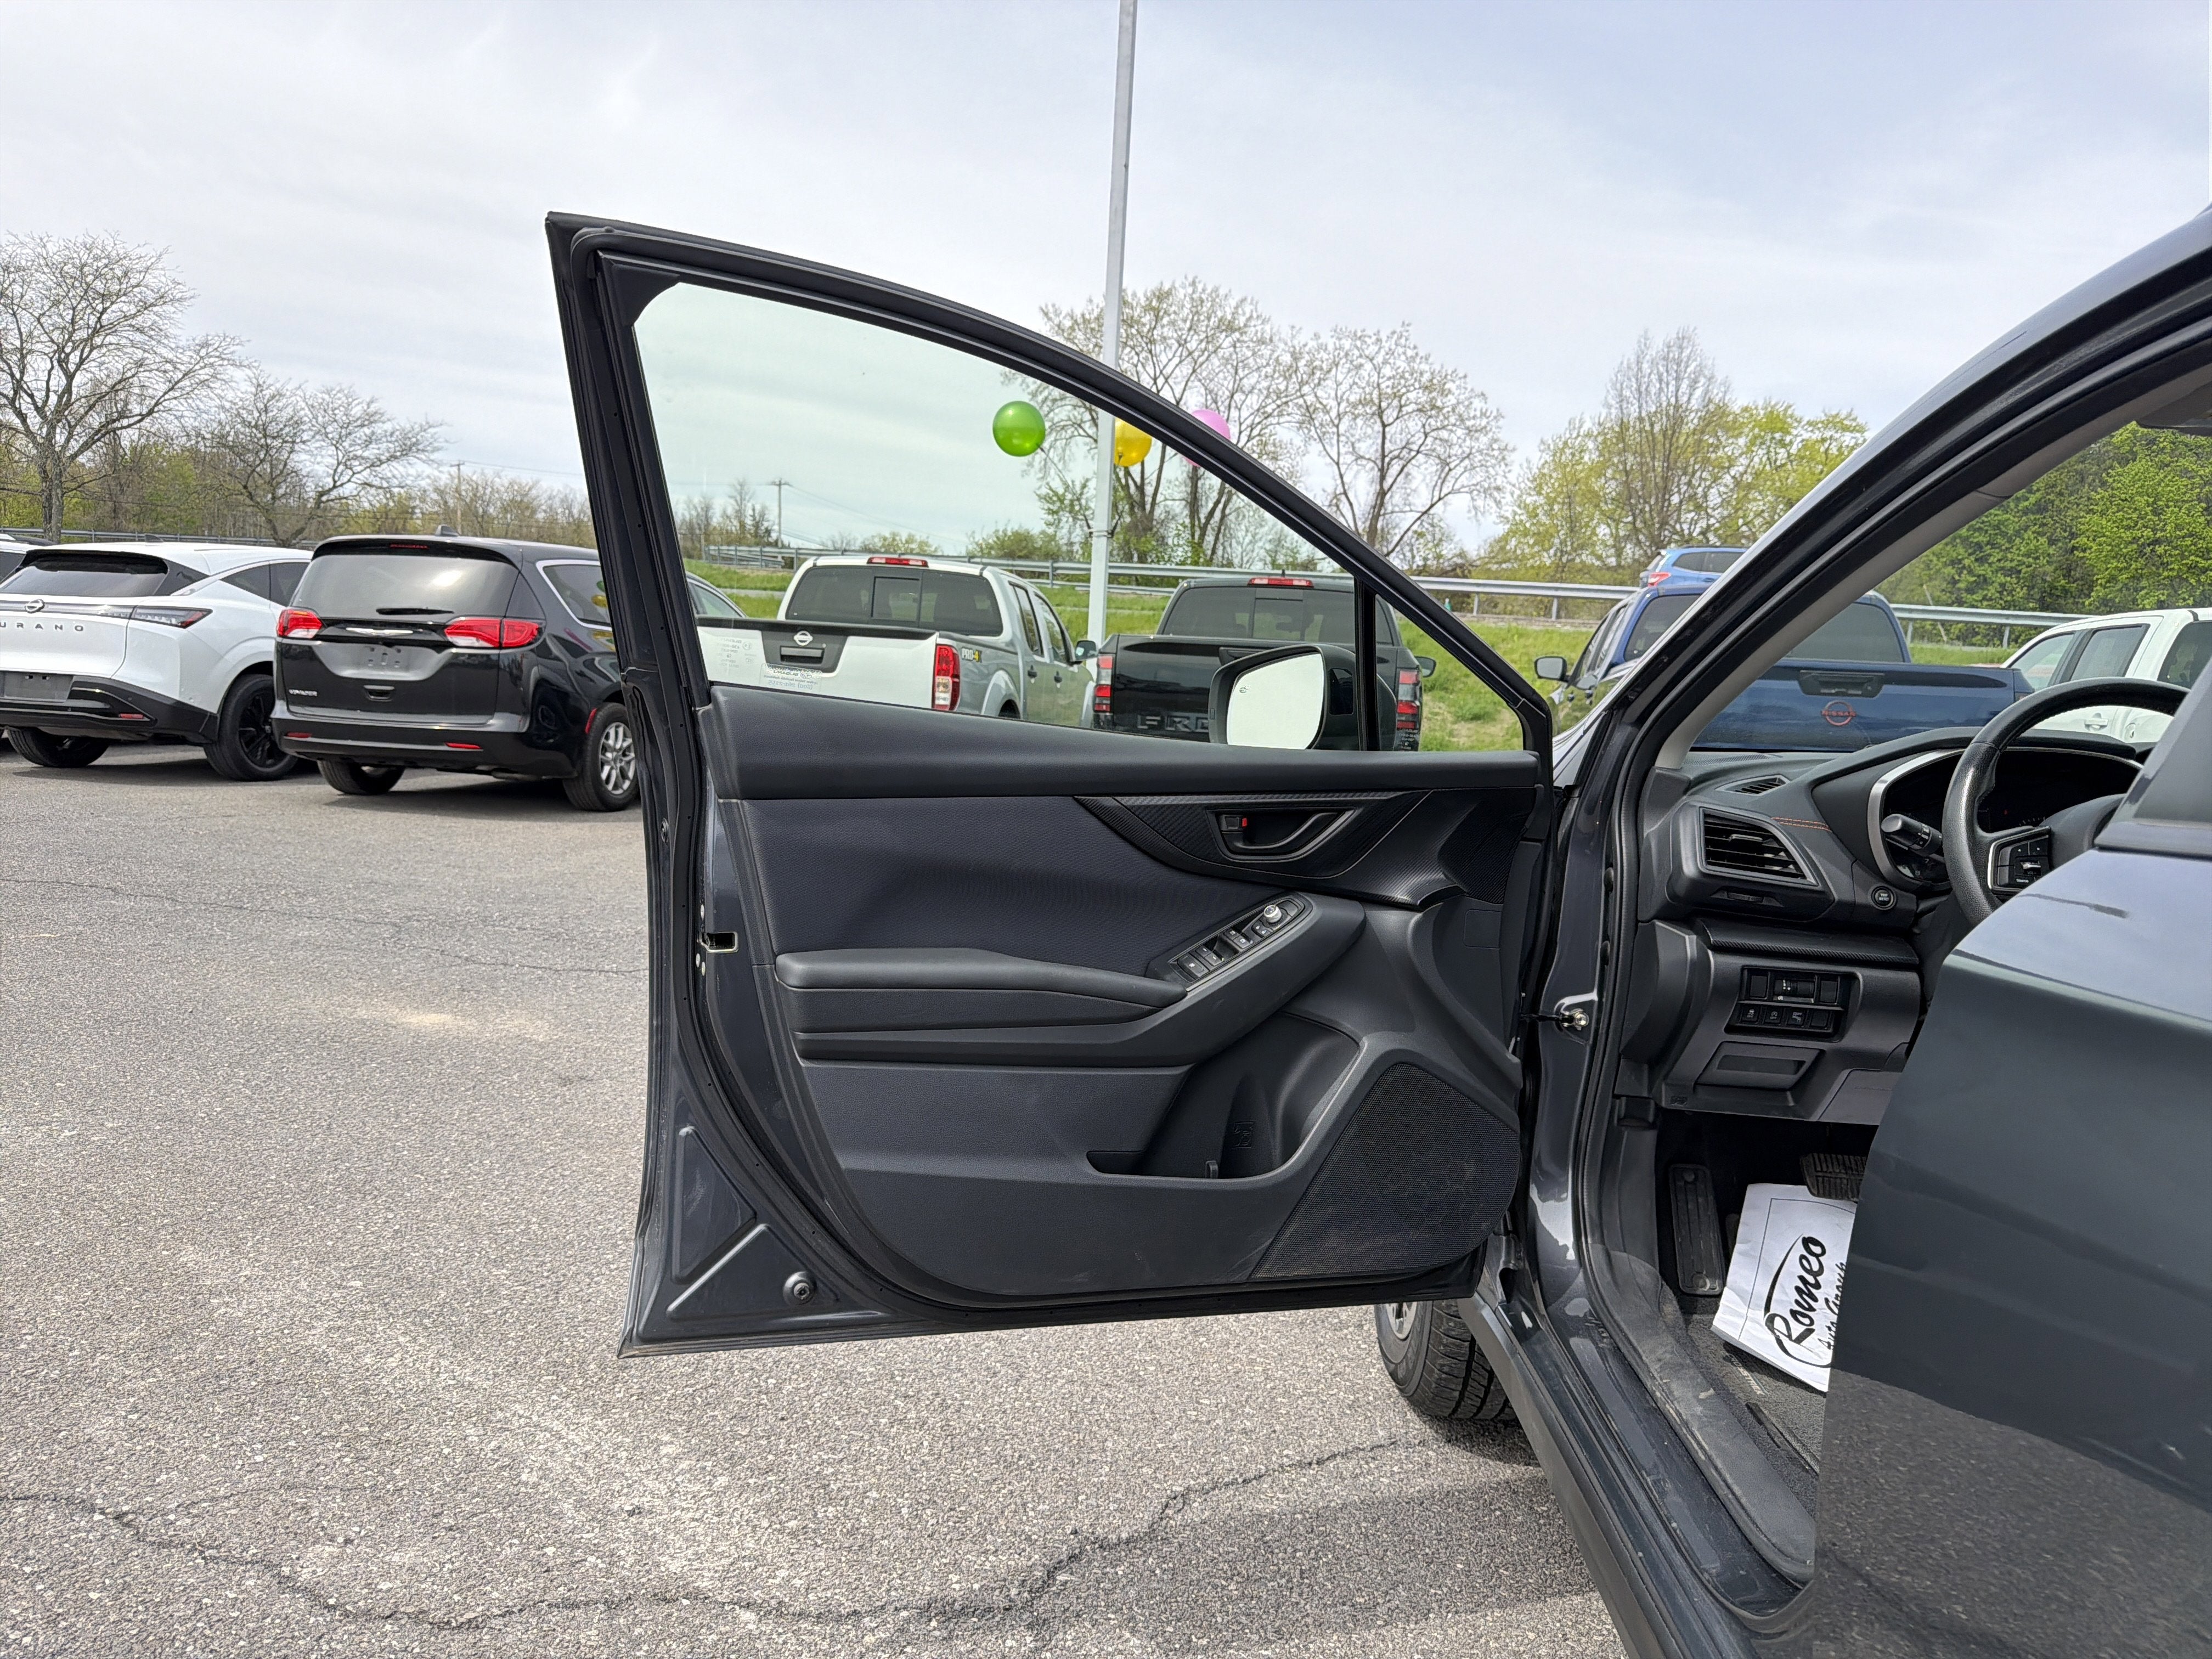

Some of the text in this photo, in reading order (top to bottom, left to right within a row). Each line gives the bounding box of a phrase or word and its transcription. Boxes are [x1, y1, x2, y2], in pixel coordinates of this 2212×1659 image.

[0, 622, 84, 631] URANO
[961, 648, 982, 663] PRO-4X
[1764, 1236, 1827, 1348] Romeo
